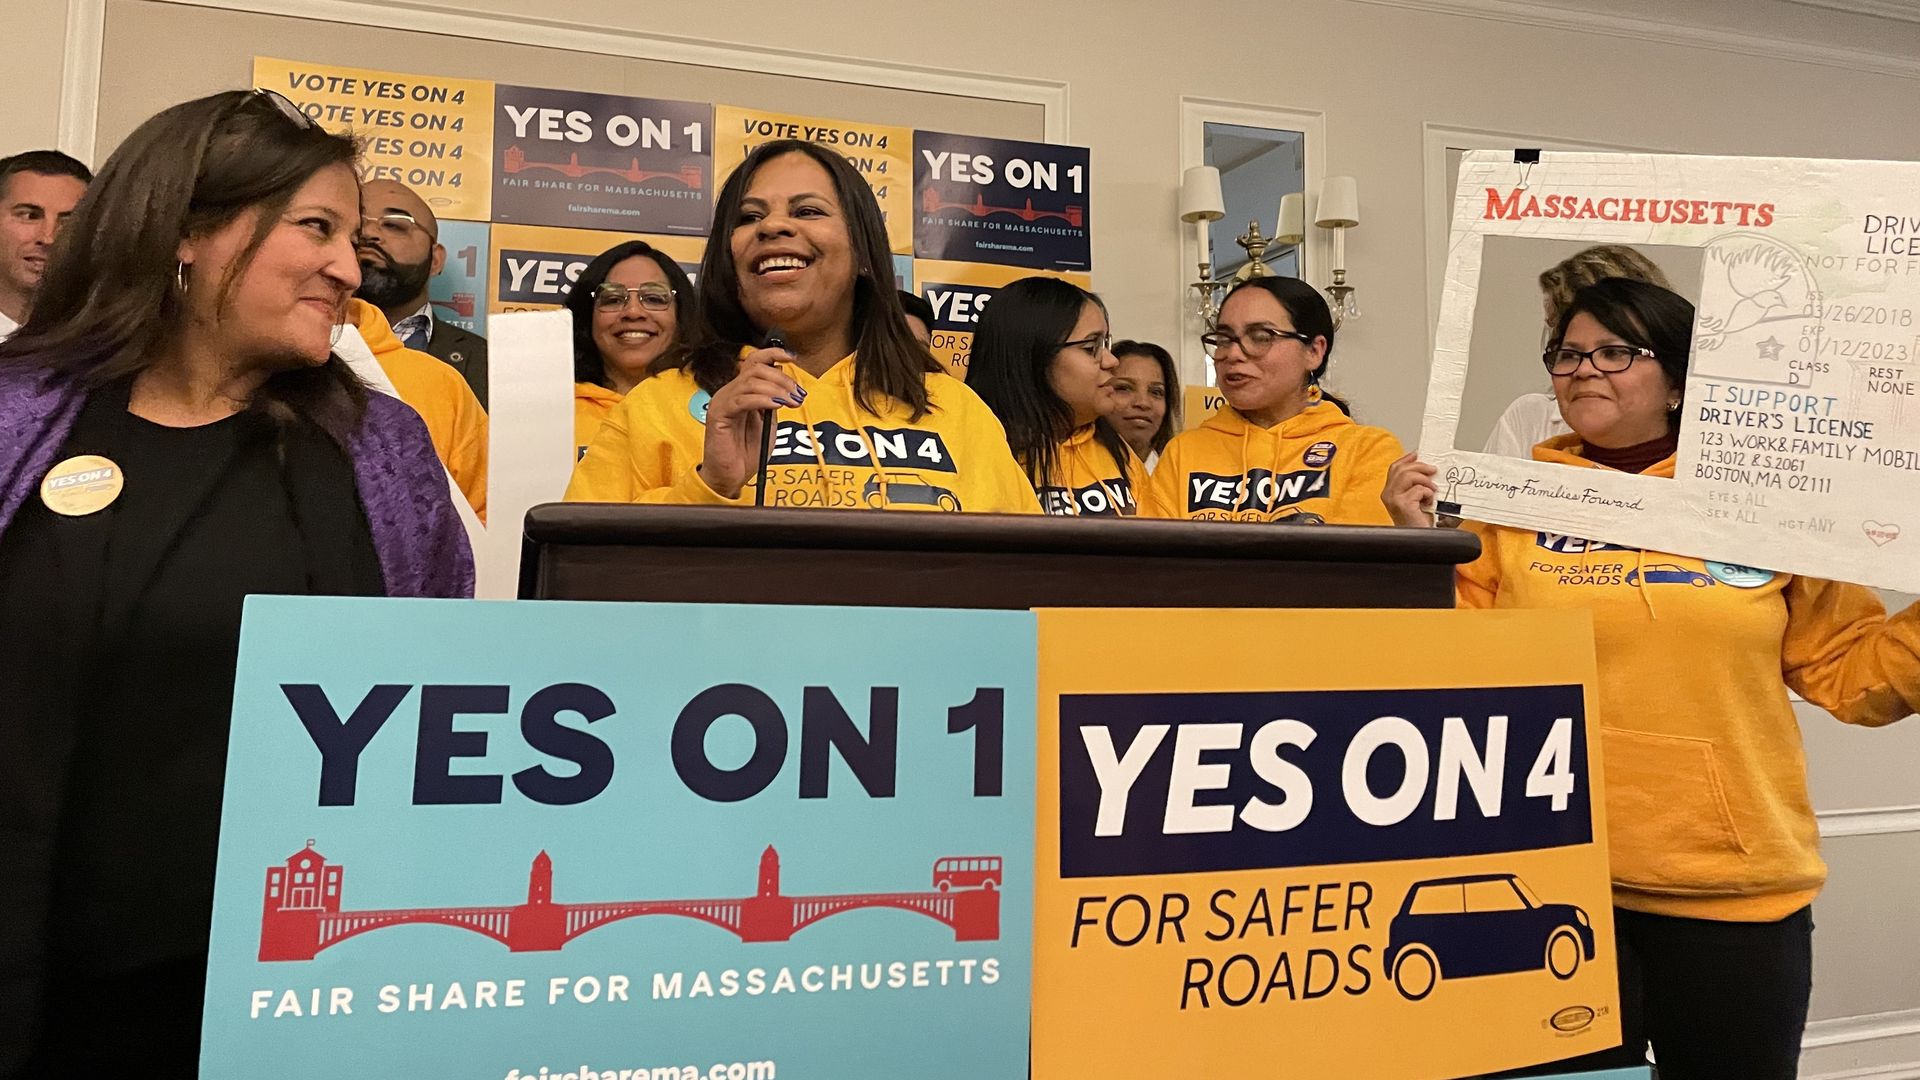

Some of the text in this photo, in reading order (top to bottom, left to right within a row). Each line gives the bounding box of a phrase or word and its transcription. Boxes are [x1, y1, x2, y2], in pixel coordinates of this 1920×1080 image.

[289, 72, 465, 105] VOTE YES ON 4
[362, 108, 405, 128] YES
[410, 113, 446, 131] ON
[451, 118, 464, 132] 4
[504, 105, 701, 152] YES ON 1
[744, 119, 888, 149] VOTE YES ON 4
[409, 141, 446, 159] ON
[450, 145, 463, 160] 4
[877, 160, 888, 174] 4
[922, 150, 1082, 194] YES ON 1
[408, 168, 444, 187] ON
[449, 173, 462, 187] 4
[503, 178, 702, 200] FAIR SHARE FOR MASSACHUSETTS
[877, 185, 888, 200] 4
[568, 204, 640, 216] fairsharema.com
[922, 216, 1083, 237] FAIR SHARE FOR MASSACHUSETTS
[457, 246, 477, 277] 1
[1806, 255, 1848, 271] NOT
[1856, 257, 1897, 274] FOR
[1803, 303, 1912, 327] 03/26/2018
[1802, 325, 1825, 335] EXP
[932, 335, 956, 349] OR
[1789, 360, 1830, 373] CLASS
[1869, 367, 1904, 379] REST
[1789, 372, 1799, 384] D
[1867, 381, 1915, 395] NONE
[1703, 383, 1838, 417] I SUPPORT
[1699, 406, 1874, 440] DRIVER'S LICENSE
[771, 426, 942, 463] ES ON 4
[1700, 431, 1723, 446] 123
[48, 468, 112, 488] YES ON 4
[1788, 475, 1831, 494] 02111
[1082, 484, 1125, 513] ON
[1192, 478, 1249, 505] YES
[1256, 475, 1306, 505] ON
[1709, 490, 1768, 508] EYES ALL
[1707, 508, 1759, 524] SEX ALL
[1779, 517, 1836, 534] HGT ANY
[1529, 561, 1624, 575] FOR SAFER
[1557, 575, 1621, 586] ROADS
[278, 681, 1004, 807] YES ON 1
[1079, 715, 1575, 837] YES ON 4
[1071, 881, 1373, 949] FOR SAFER
[1179, 944, 1373, 1010] ROADS
[250, 957, 1001, 1019] FAIR SHARE FOR MASSACHUSETTS
